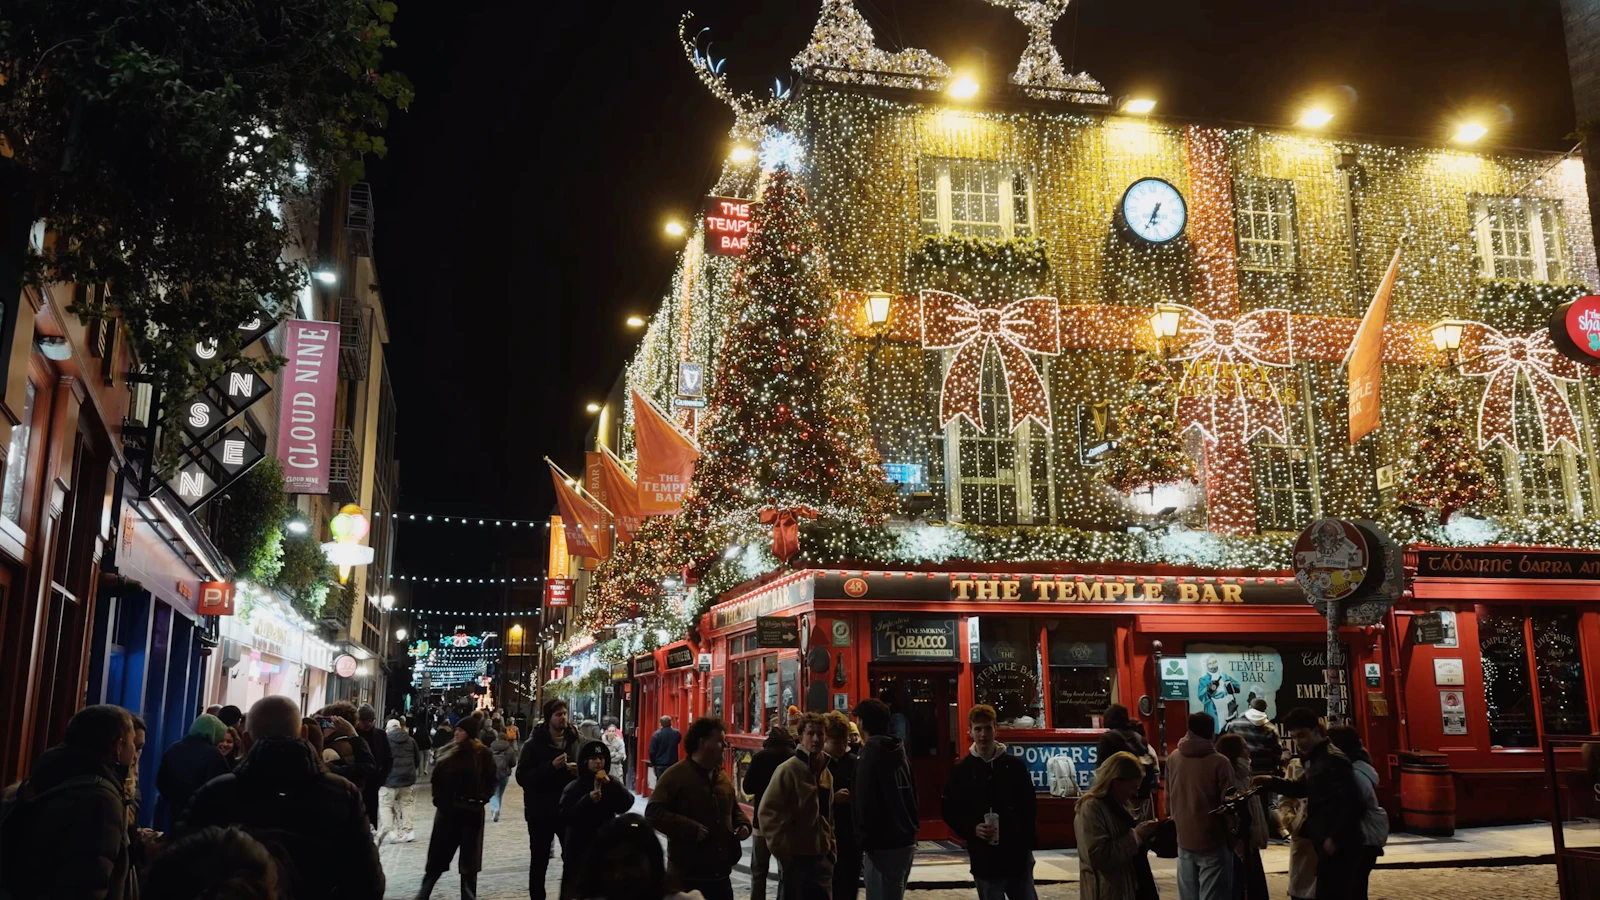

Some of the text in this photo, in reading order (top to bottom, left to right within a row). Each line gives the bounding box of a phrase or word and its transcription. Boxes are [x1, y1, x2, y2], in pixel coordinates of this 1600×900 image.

[720, 202, 750, 217] THE
[294, 327, 330, 384] NINE
[1182, 361, 1273, 382] MERRY
[1173, 380, 1297, 405] HRISTMAS
[287, 392, 320, 469] CLOUD
[286, 475, 305, 484] CLOUD
[305, 477, 319, 485] NINE
[591, 469, 600, 489] BAR
[658, 473, 680, 483] THE
[642, 482, 687, 492] TEMPL
[655, 493, 683, 503] BAR
[952, 580, 1244, 603] THE TEMPLE BAR
[875, 616, 910, 631] Importers
[885, 631, 947, 653] TOBACCO
[1535, 633, 1551, 649] LIVE
[1000, 651, 1015, 659] THE
[1239, 651, 1263, 661] THE
[976, 662, 1017, 682] TEMPLE
[1228, 661, 1275, 672] TEMPLE
[1241, 672, 1266, 683] BAR
